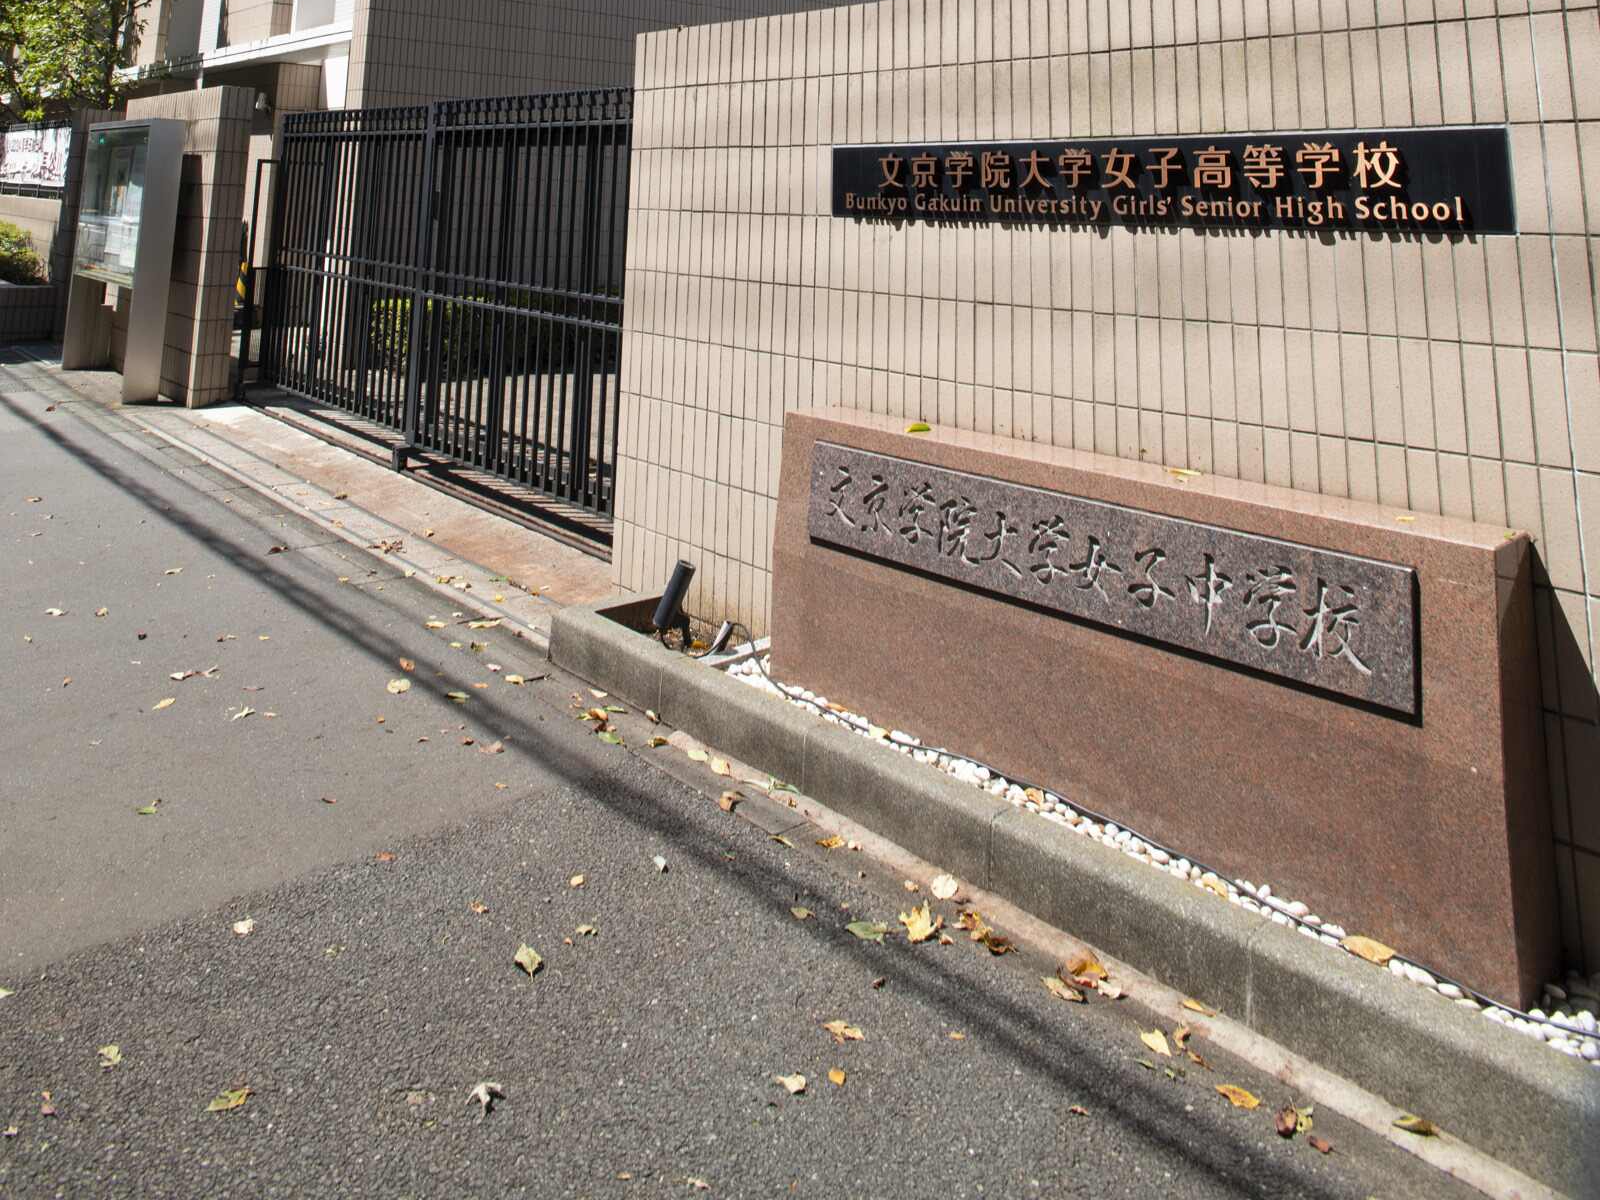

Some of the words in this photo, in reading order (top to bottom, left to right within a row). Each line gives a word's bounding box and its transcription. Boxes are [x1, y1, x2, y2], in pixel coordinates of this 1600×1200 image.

[877, 140, 1402, 190] 文京学院大学女子高等学校
[845, 192, 907, 215] Bunkyo
[914, 193, 981, 213] Gakuin
[989, 194, 1102, 220] University
[1180, 194, 1263, 218] Senior
[1275, 195, 1344, 225] High
[1354, 196, 1464, 224] School
[825, 465, 1373, 676] 文京学院大学女子中学校
